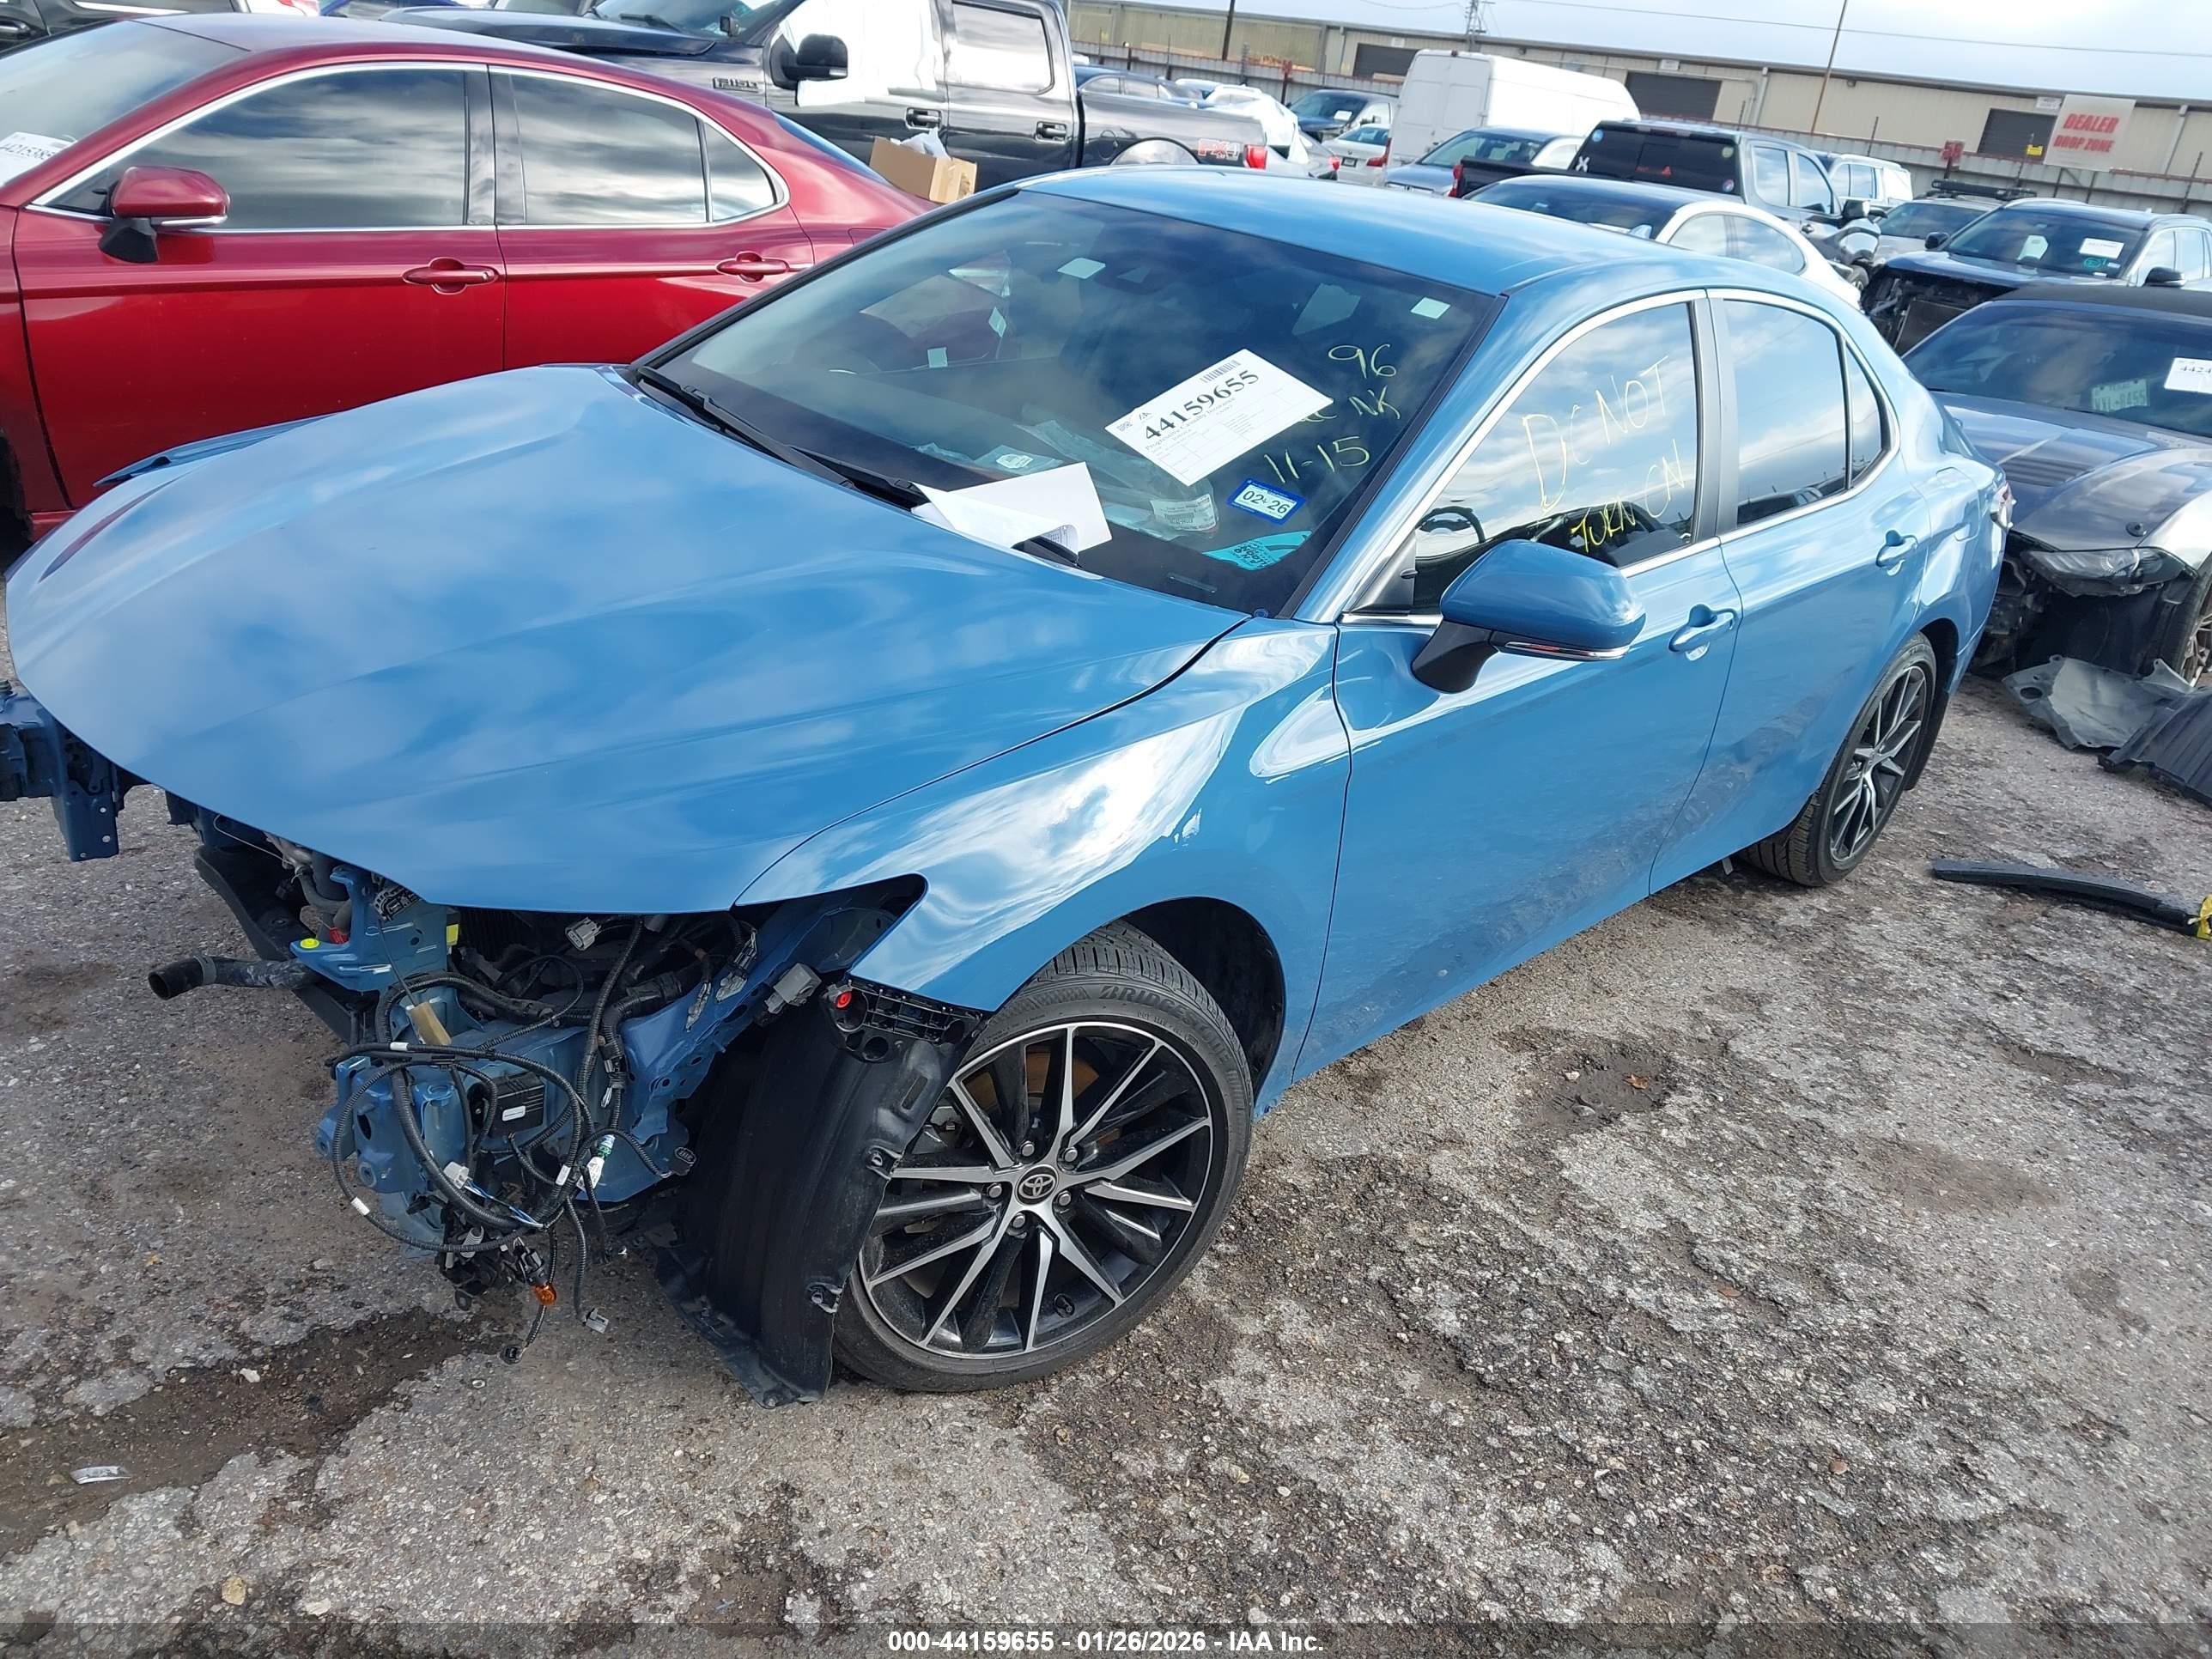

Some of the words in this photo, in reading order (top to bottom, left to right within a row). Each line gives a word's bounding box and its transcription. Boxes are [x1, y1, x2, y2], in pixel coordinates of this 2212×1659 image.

[2063, 112, 2119, 134] DEALER
[1198, 138, 1240, 161] FX4
[2053, 134, 2085, 149] DROP
[2083, 137, 2115, 153] ZONE
[1328, 343, 1397, 379] 96
[1145, 369, 1260, 440] 44159655
[1595, 355, 1669, 446] NOT
[1243, 490, 1265, 505] 02
[1267, 500, 1291, 514] 26
[1098, 985, 1231, 1065] BRIDGESTONE
